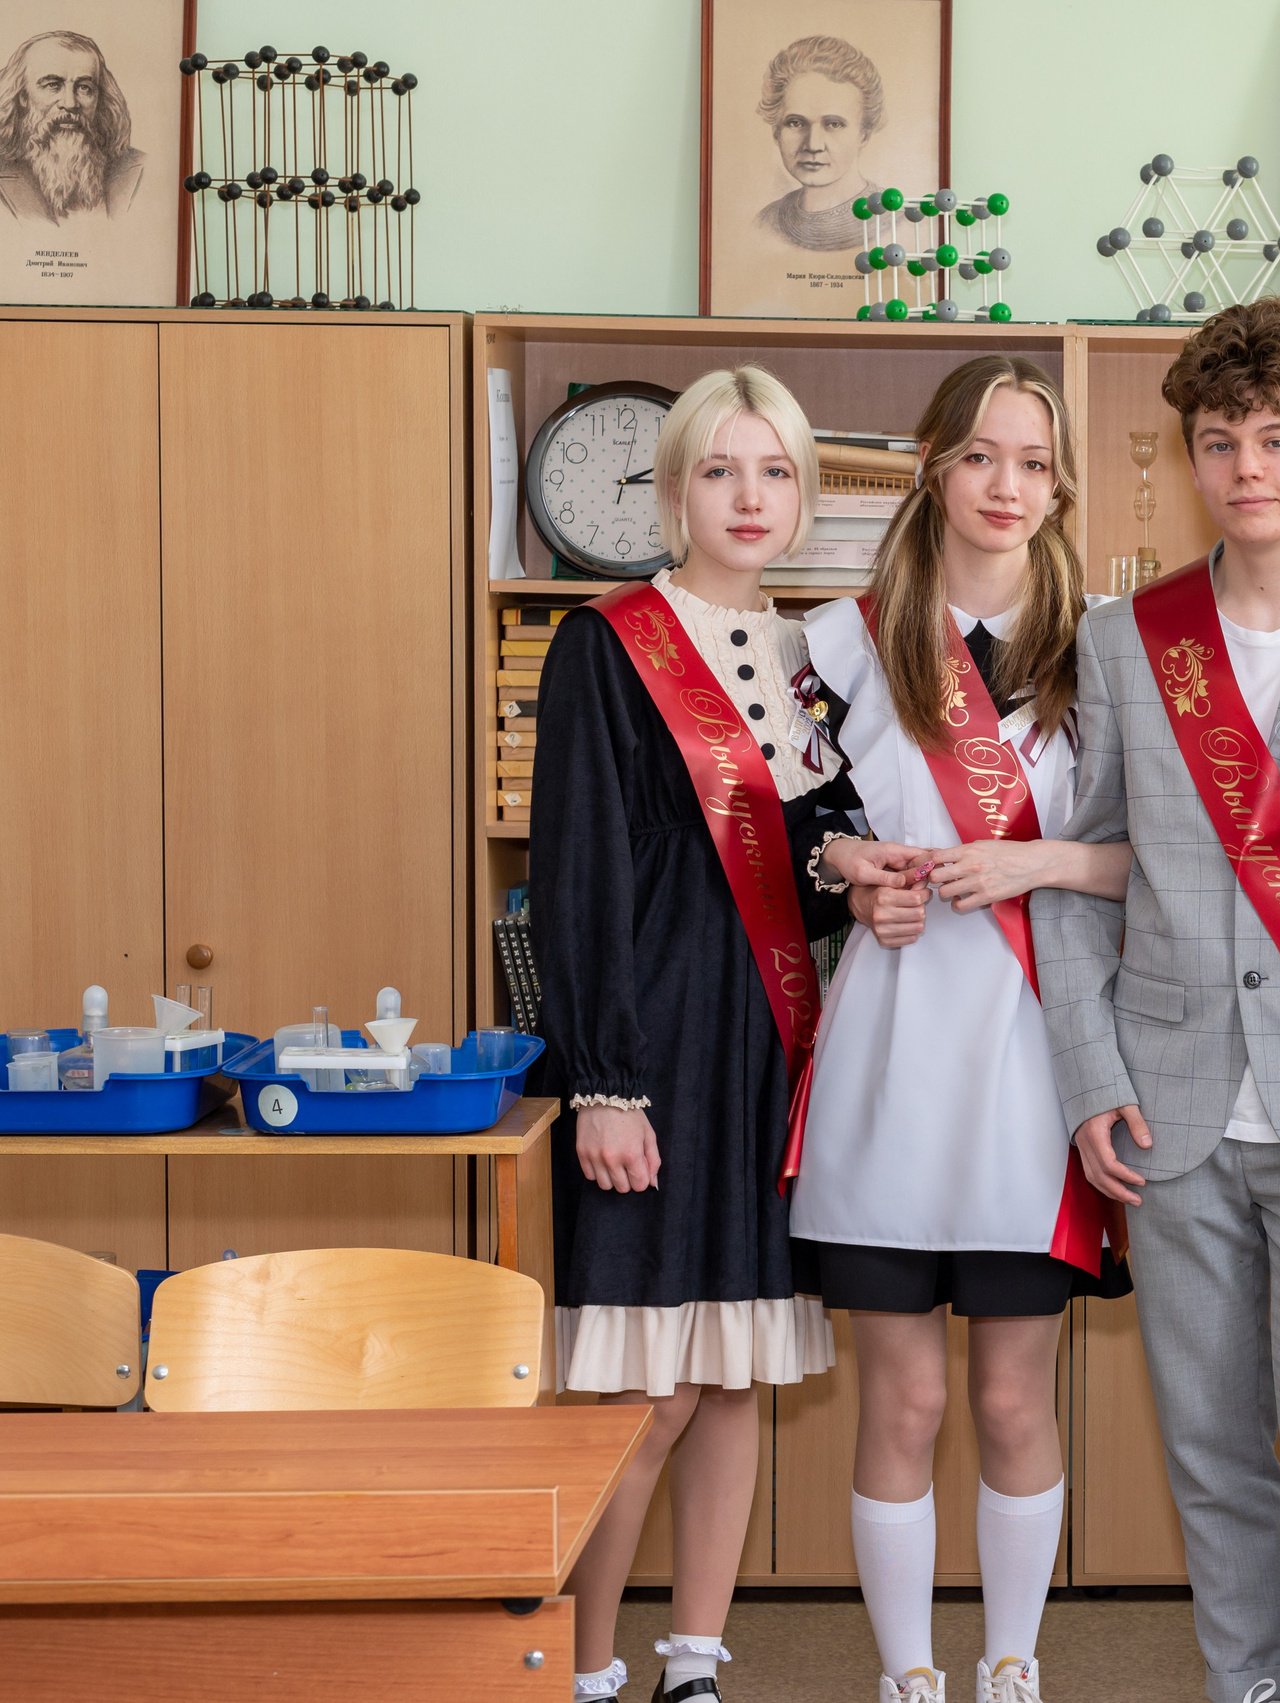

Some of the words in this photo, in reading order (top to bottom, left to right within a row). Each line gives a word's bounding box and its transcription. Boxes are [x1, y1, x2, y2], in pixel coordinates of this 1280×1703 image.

[26, 260, 54, 268] Дмитрий
[590, 414, 604, 436] 11
[616, 408, 635, 429] 12
[561, 442, 588, 464] 10
[550, 469, 565, 491] 9
[559, 501, 575, 524] 8
[586, 525, 600, 546] 7
[615, 532, 632, 555] 6
[647, 525, 662, 547] 5
[272, 1098, 283, 1114] 4
